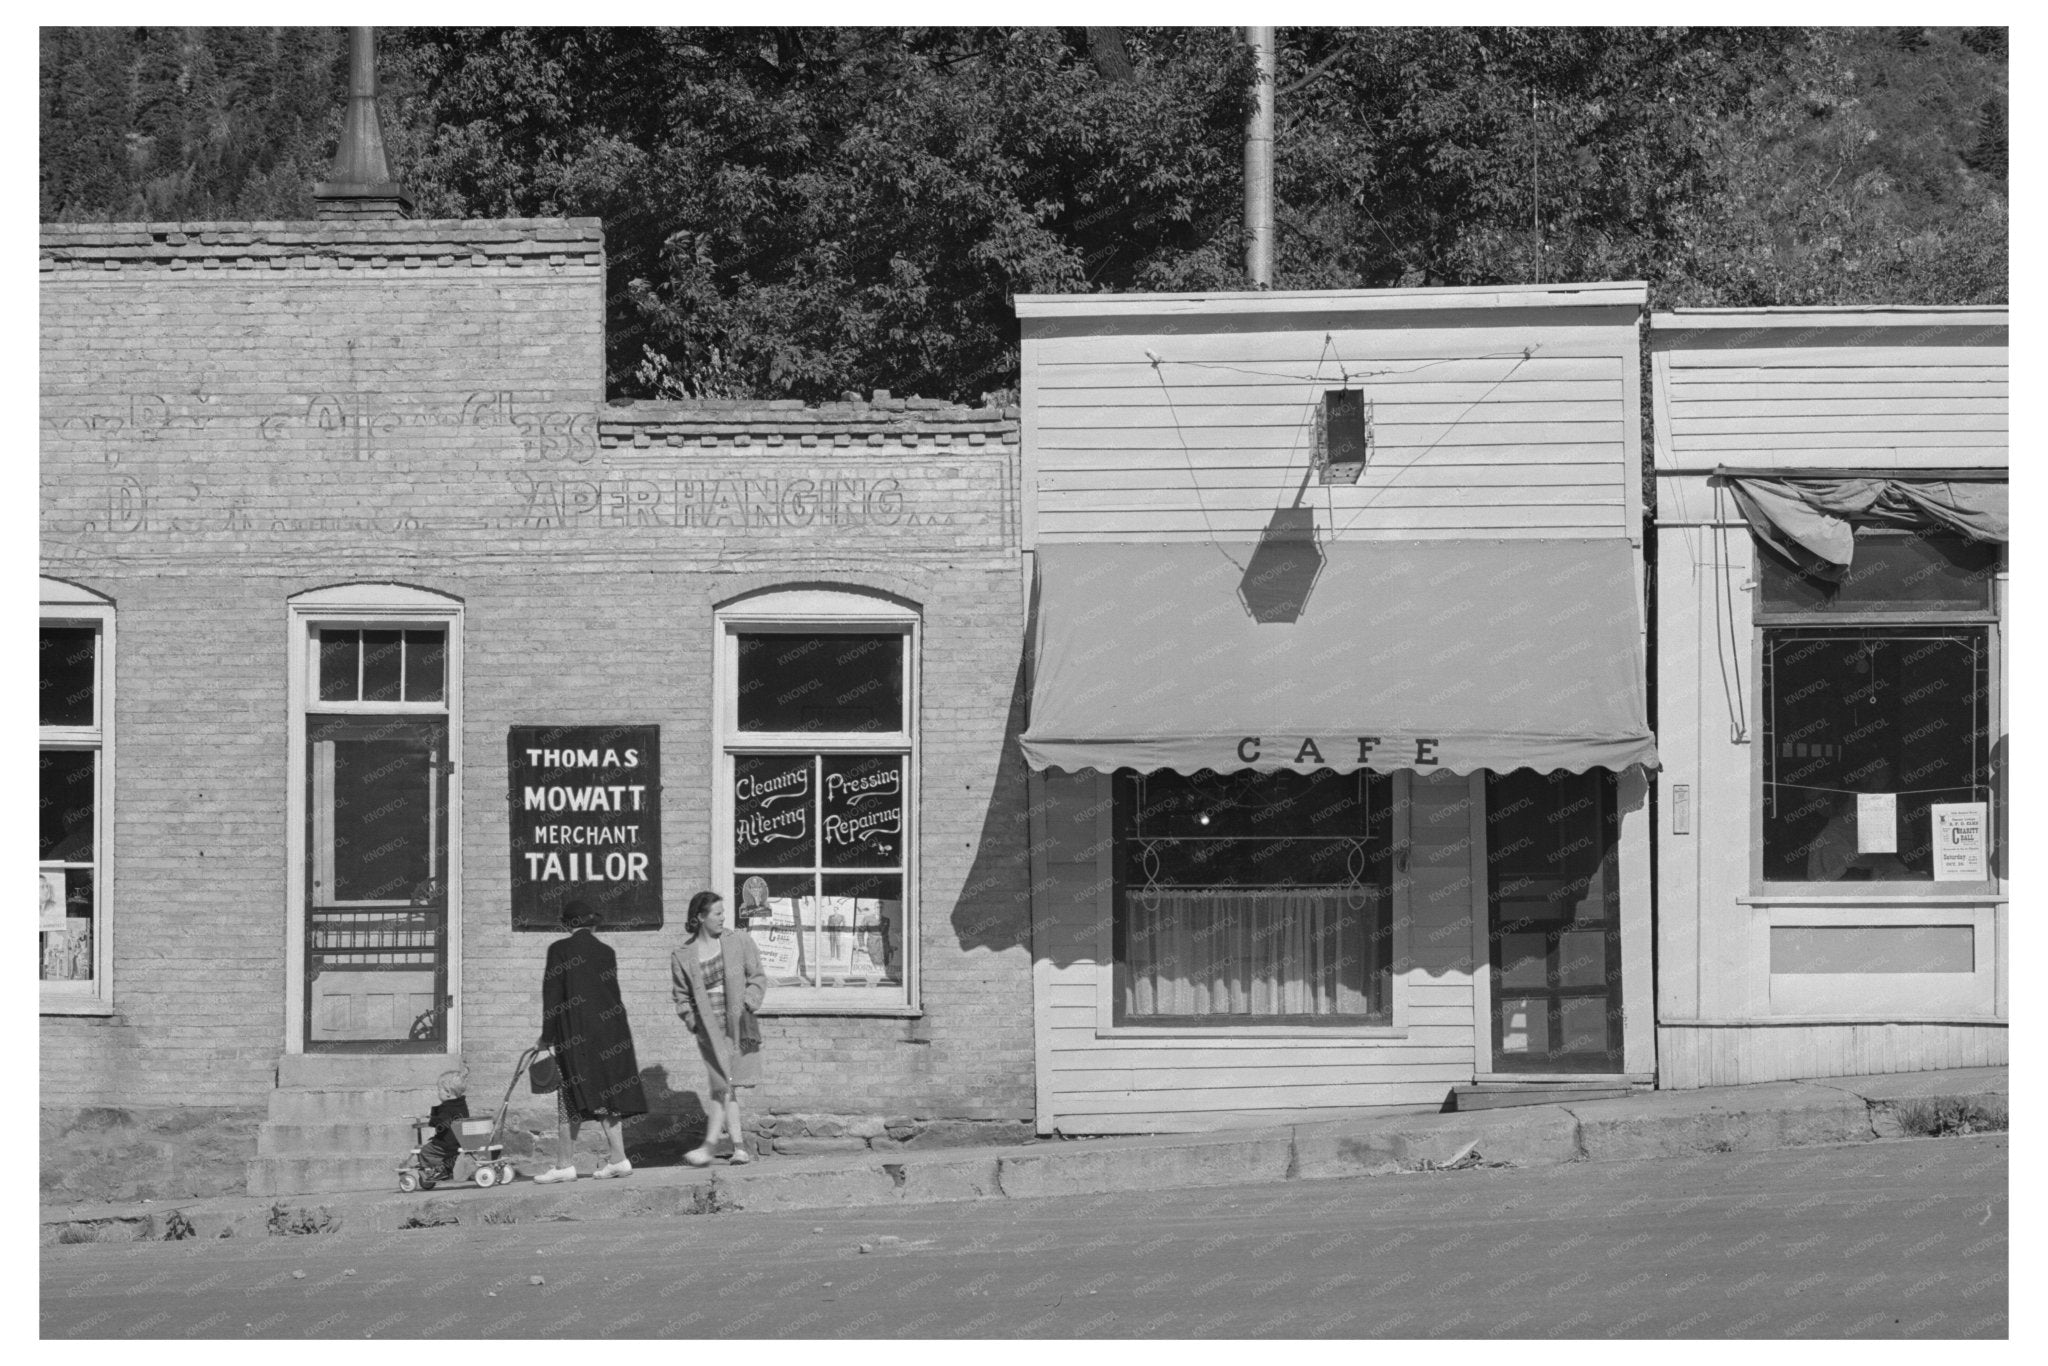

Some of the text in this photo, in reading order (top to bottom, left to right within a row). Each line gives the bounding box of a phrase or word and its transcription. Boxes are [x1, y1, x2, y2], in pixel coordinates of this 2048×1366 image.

[675, 478, 903, 528] HANGING
[526, 749, 639, 768] THOMAS
[1237, 736, 1439, 765] CAFE
[524, 785, 645, 811] MOWATT
[736, 769, 807, 807] Cleaning
[825, 770, 900, 806] Pressing
[535, 825, 639, 845] MERCHANT
[737, 808, 806, 846] Altering
[823, 808, 901, 845] Repairing
[524, 852, 649, 881] TAILOR
